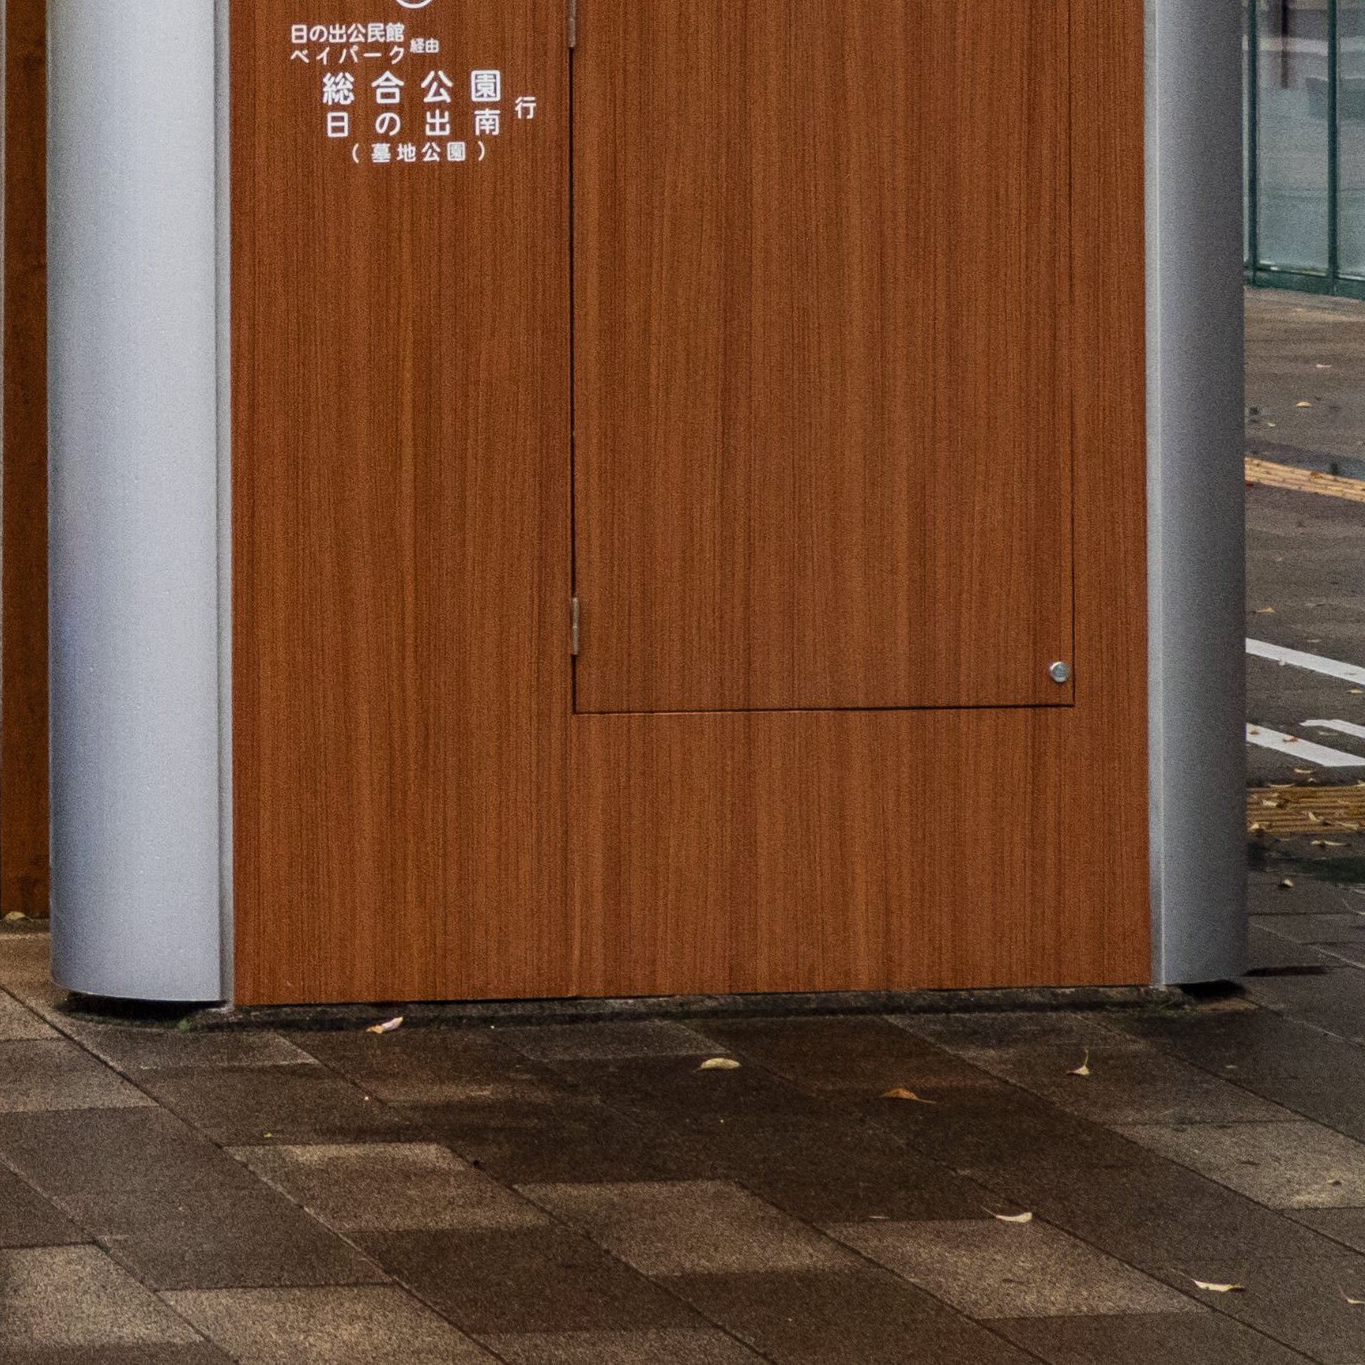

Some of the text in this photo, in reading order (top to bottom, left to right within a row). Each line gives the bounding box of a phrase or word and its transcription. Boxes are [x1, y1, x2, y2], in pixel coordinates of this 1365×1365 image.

[291, 23, 405, 43] 日の出公民館
[291, 46, 405, 65] ベイパーク
[410, 38, 440, 54] 経由
[323, 70, 501, 104] 総合公園
[327, 109, 501, 137] 日の出南
